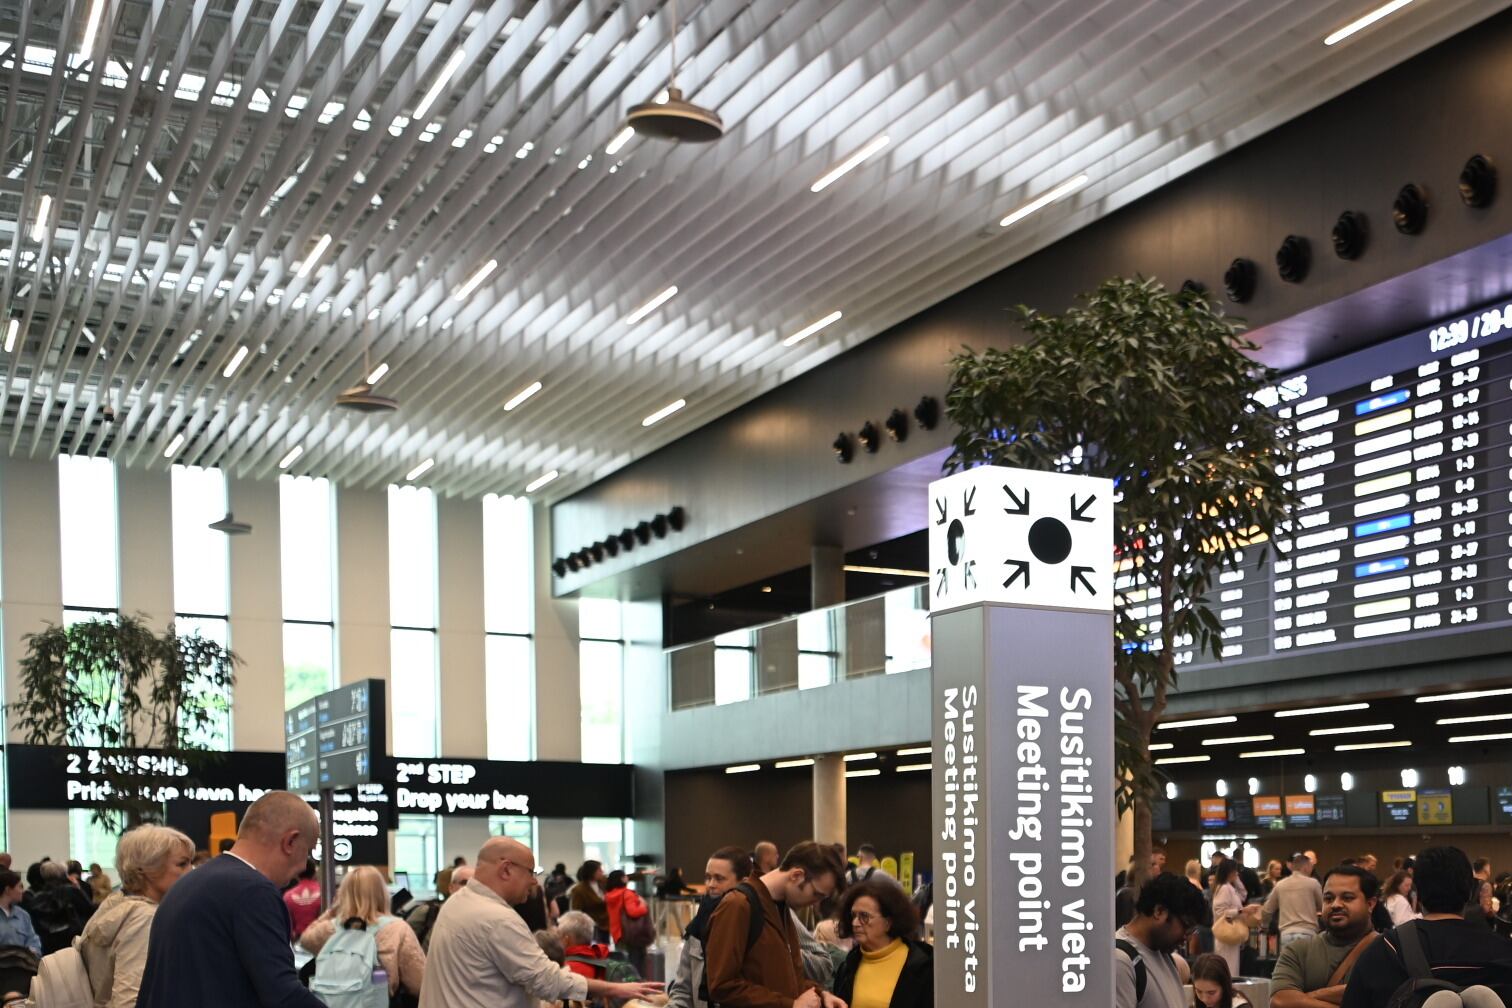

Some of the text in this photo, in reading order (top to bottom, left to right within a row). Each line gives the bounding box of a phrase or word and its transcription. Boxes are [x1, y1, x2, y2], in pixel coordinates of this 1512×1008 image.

[67, 754, 80, 774] 2
[397, 788, 442, 812] Drop
[446, 793, 490, 812] your
[493, 790, 529, 814] bag
[428, 764, 476, 785] STEP
[942, 687, 959, 949] Meeting point
[962, 685, 979, 993] Susitikimo vieta
[1009, 685, 1051, 952] Meeting point
[1060, 687, 1094, 993] Susitikimo vieta
